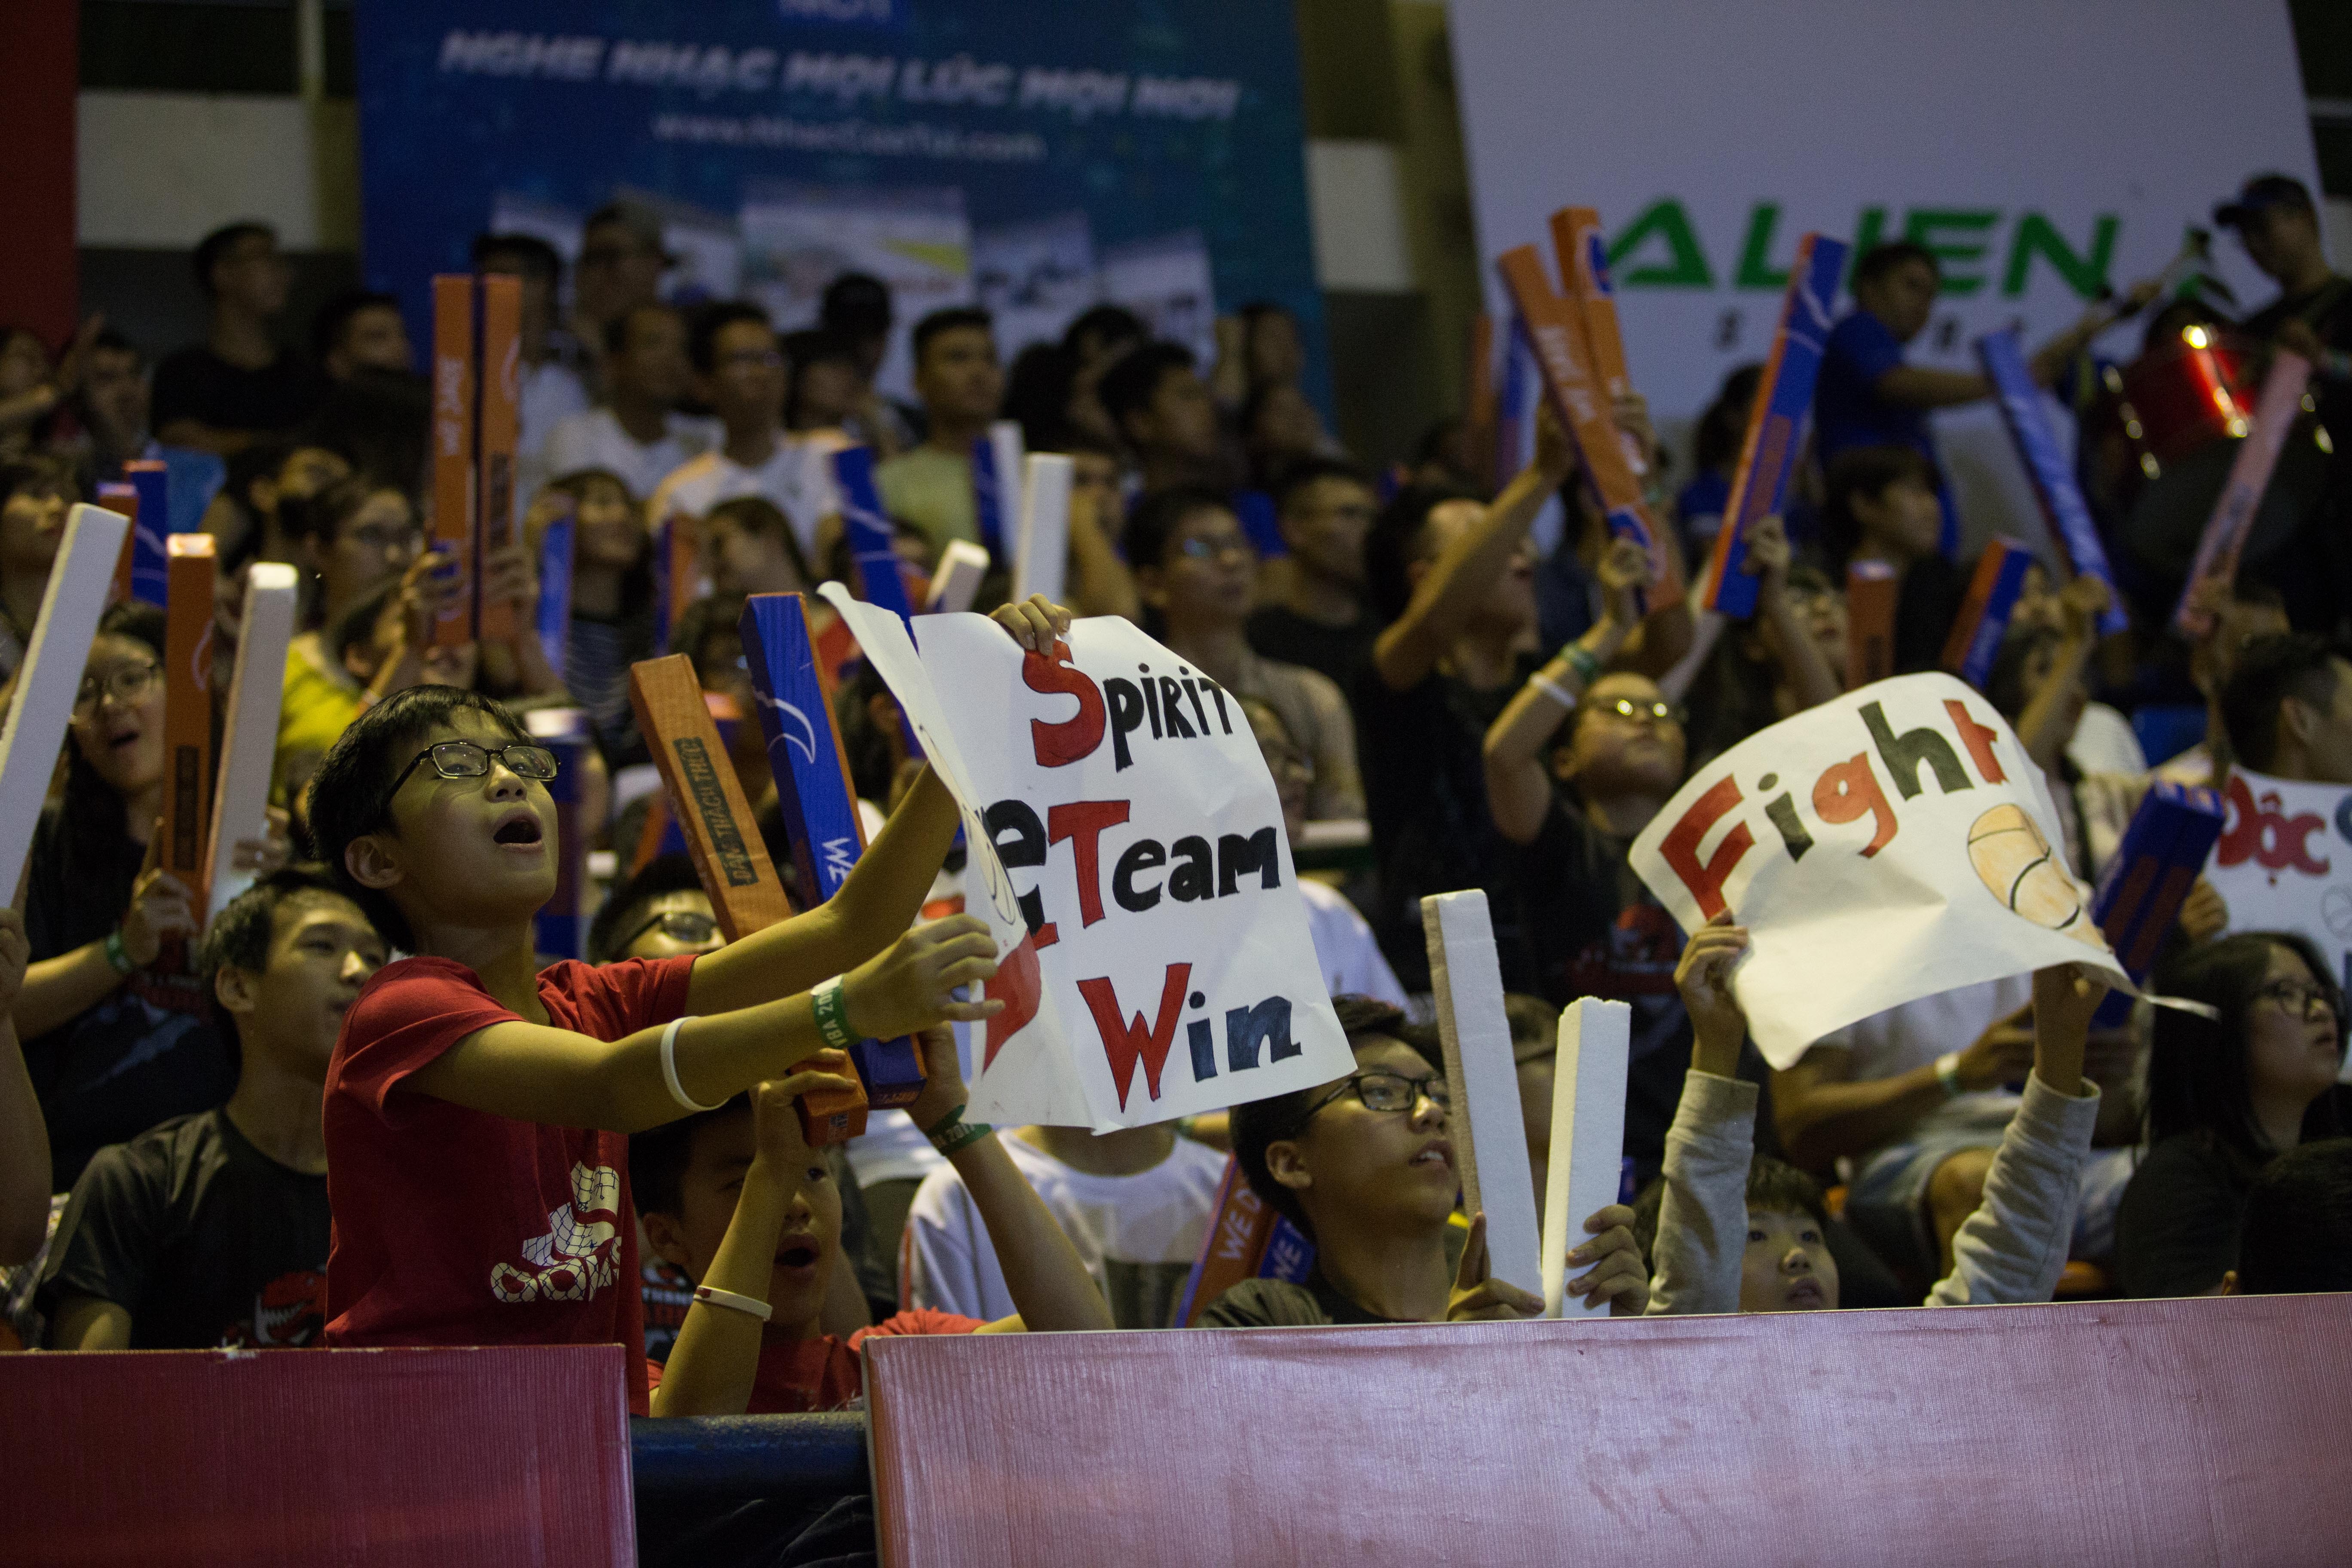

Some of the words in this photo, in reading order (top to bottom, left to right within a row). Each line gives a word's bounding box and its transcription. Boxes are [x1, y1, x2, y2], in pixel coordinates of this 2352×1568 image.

[821, 837, 854, 884] WE
[1047, 799, 1280, 929] Team
[1659, 700, 2010, 921] Fight
[1076, 963, 1302, 1113] Win
[1217, 1210, 1254, 1260] WE
